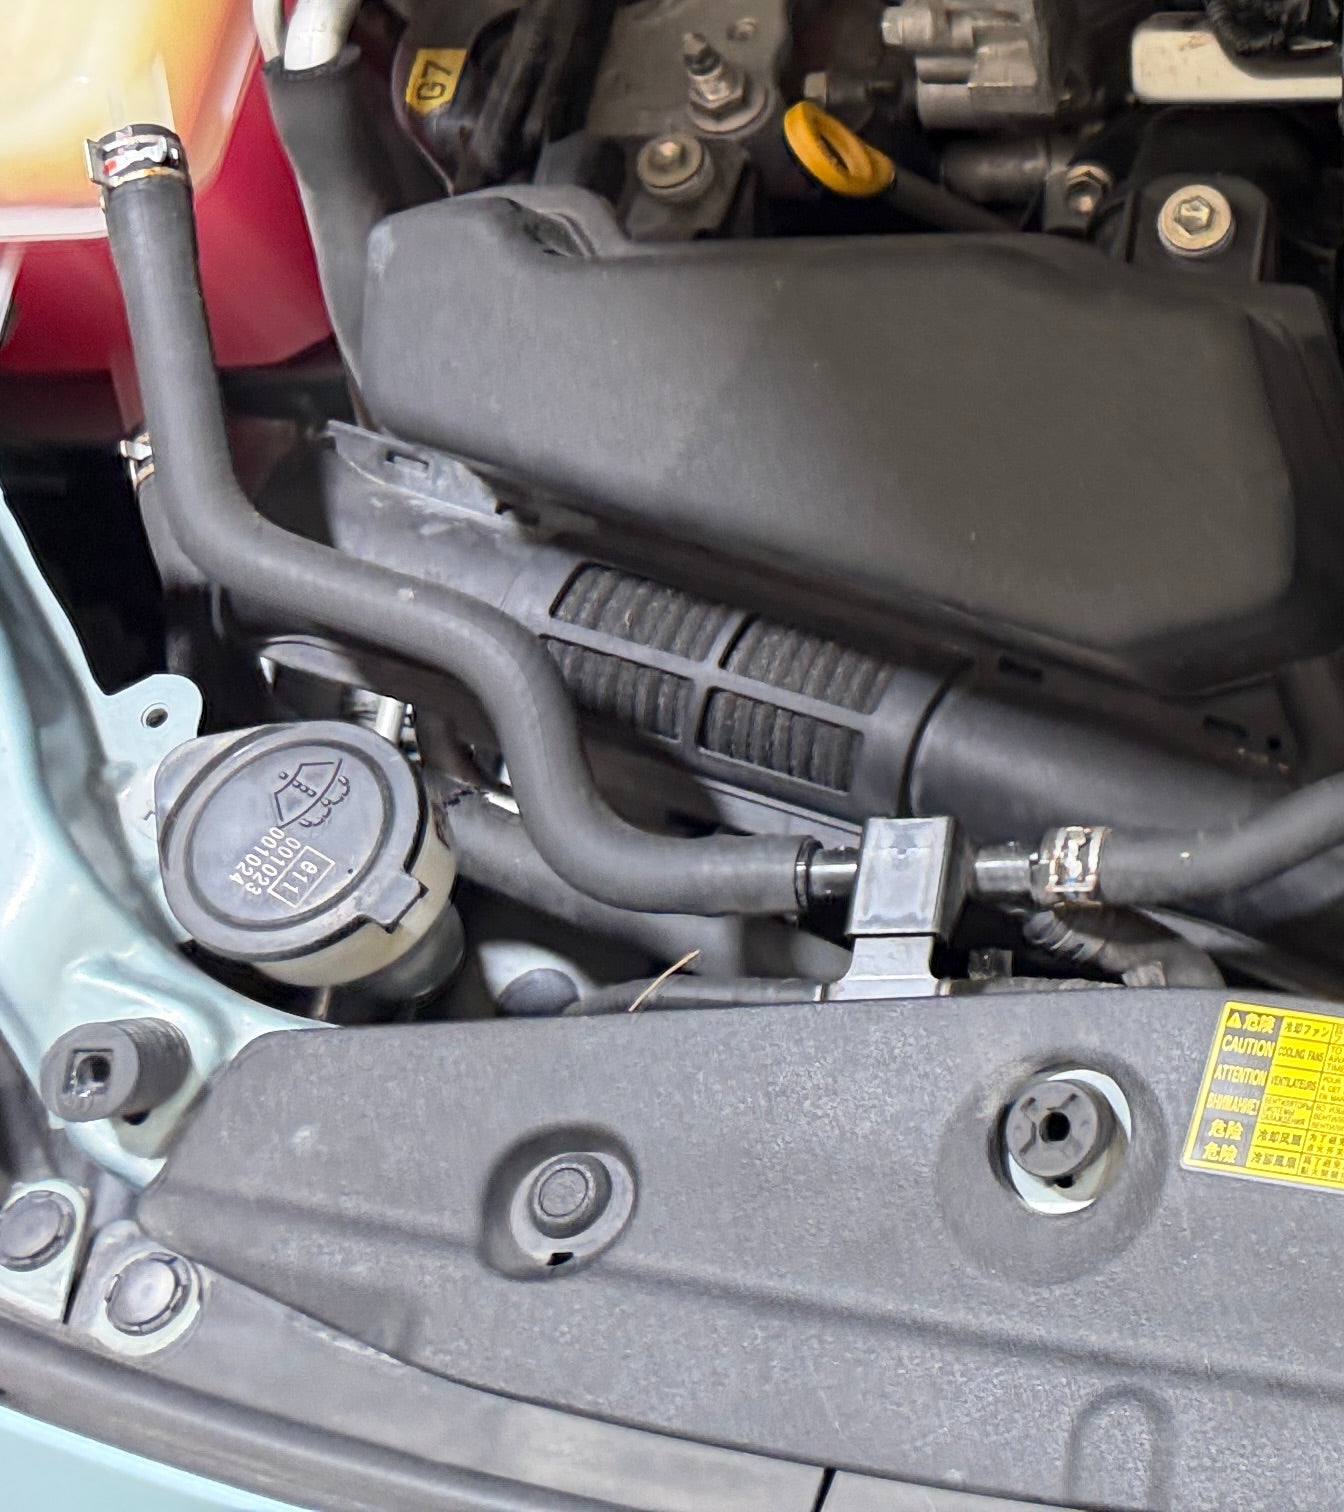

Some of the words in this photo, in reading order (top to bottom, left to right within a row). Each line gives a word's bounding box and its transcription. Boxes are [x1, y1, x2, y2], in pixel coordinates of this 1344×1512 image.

[414, 57, 454, 103] G7
[228, 826, 285, 886] 001024
[246, 837, 301, 896] 001023
[291, 861, 319, 894] e11
[1242, 1012, 1277, 1034] 危険
[1220, 1033, 1276, 1058] CAUTION
[1277, 1045, 1306, 1059] COOLING
[1306, 1049, 1324, 1062] FANS
[1329, 1045, 1343, 1055] TO
[1212, 1062, 1268, 1087] ATTENTION
[1207, 1117, 1245, 1141] 危险
